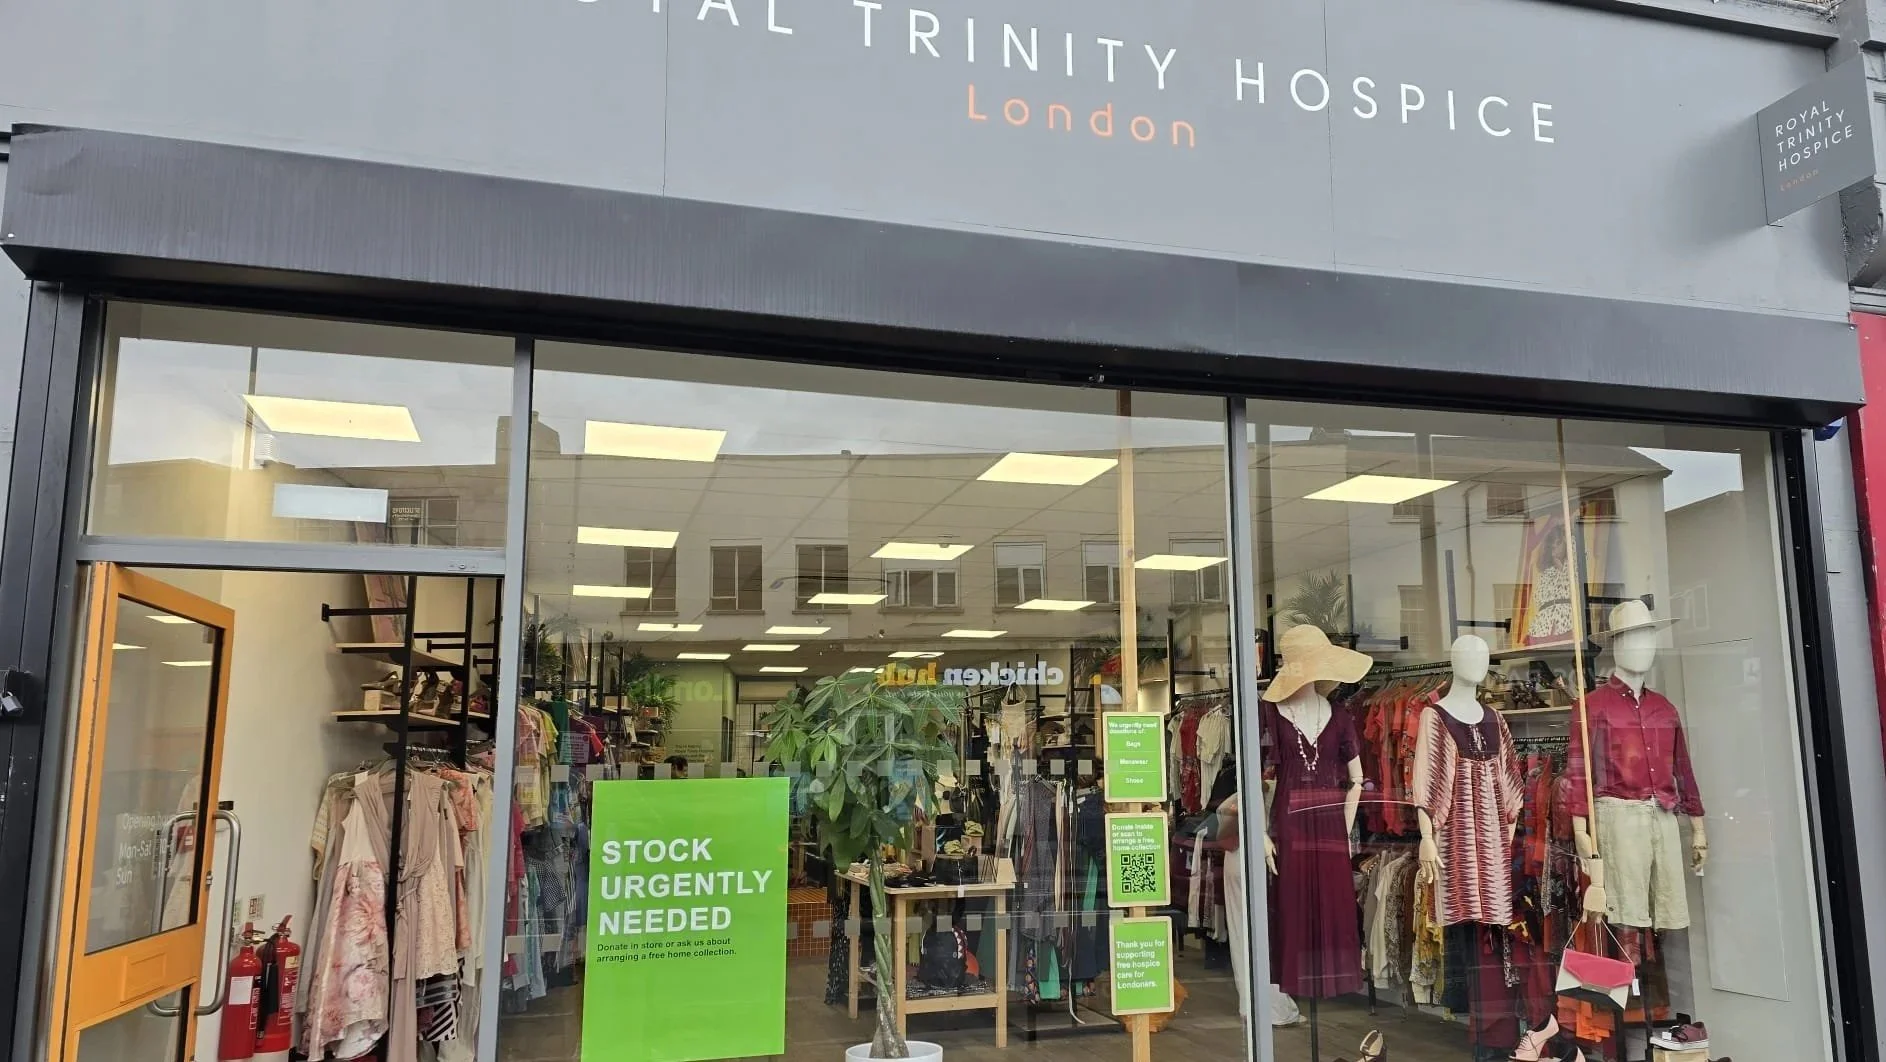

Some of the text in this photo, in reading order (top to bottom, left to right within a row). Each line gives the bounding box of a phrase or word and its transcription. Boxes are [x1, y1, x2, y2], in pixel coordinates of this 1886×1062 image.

[854, 0, 1177, 90] TRINITY
[1234, 58, 1555, 144] HOSPICE
[968, 83, 1195, 148] London
[1775, 100, 1831, 137] ROYAL
[1777, 109, 1846, 153] TRINITY
[1778, 124, 1853, 172] HOSPICE
[1780, 168, 1820, 192] London
[1126, 740, 1141, 748] Bags
[1111, 823, 1134, 831] Donate
[119, 839, 152, 861] Mon-Sat
[601, 837, 713, 865] STOCK
[1112, 838, 1136, 846] arrange
[116, 867, 133, 885] Sun
[601, 870, 773, 900] URGENTLY
[599, 906, 732, 936] NEEDED
[597, 943, 628, 951] Donate
[630, 942, 639, 950] in
[641, 941, 663, 949] store
[676, 939, 691, 947] ask
[706, 938, 731, 946] about
[1116, 941, 1139, 949] Thank
[1140, 941, 1153, 949] you
[596, 953, 639, 963] arranging
[648, 951, 665, 959] free
[667, 950, 691, 958] home
[694, 948, 737, 957] collection.
[1116, 951, 1155, 959] supporting
[1132, 960, 1160, 968] hospice
[1134, 970, 1145, 978] for
[1117, 980, 1157, 989] Londoners.
